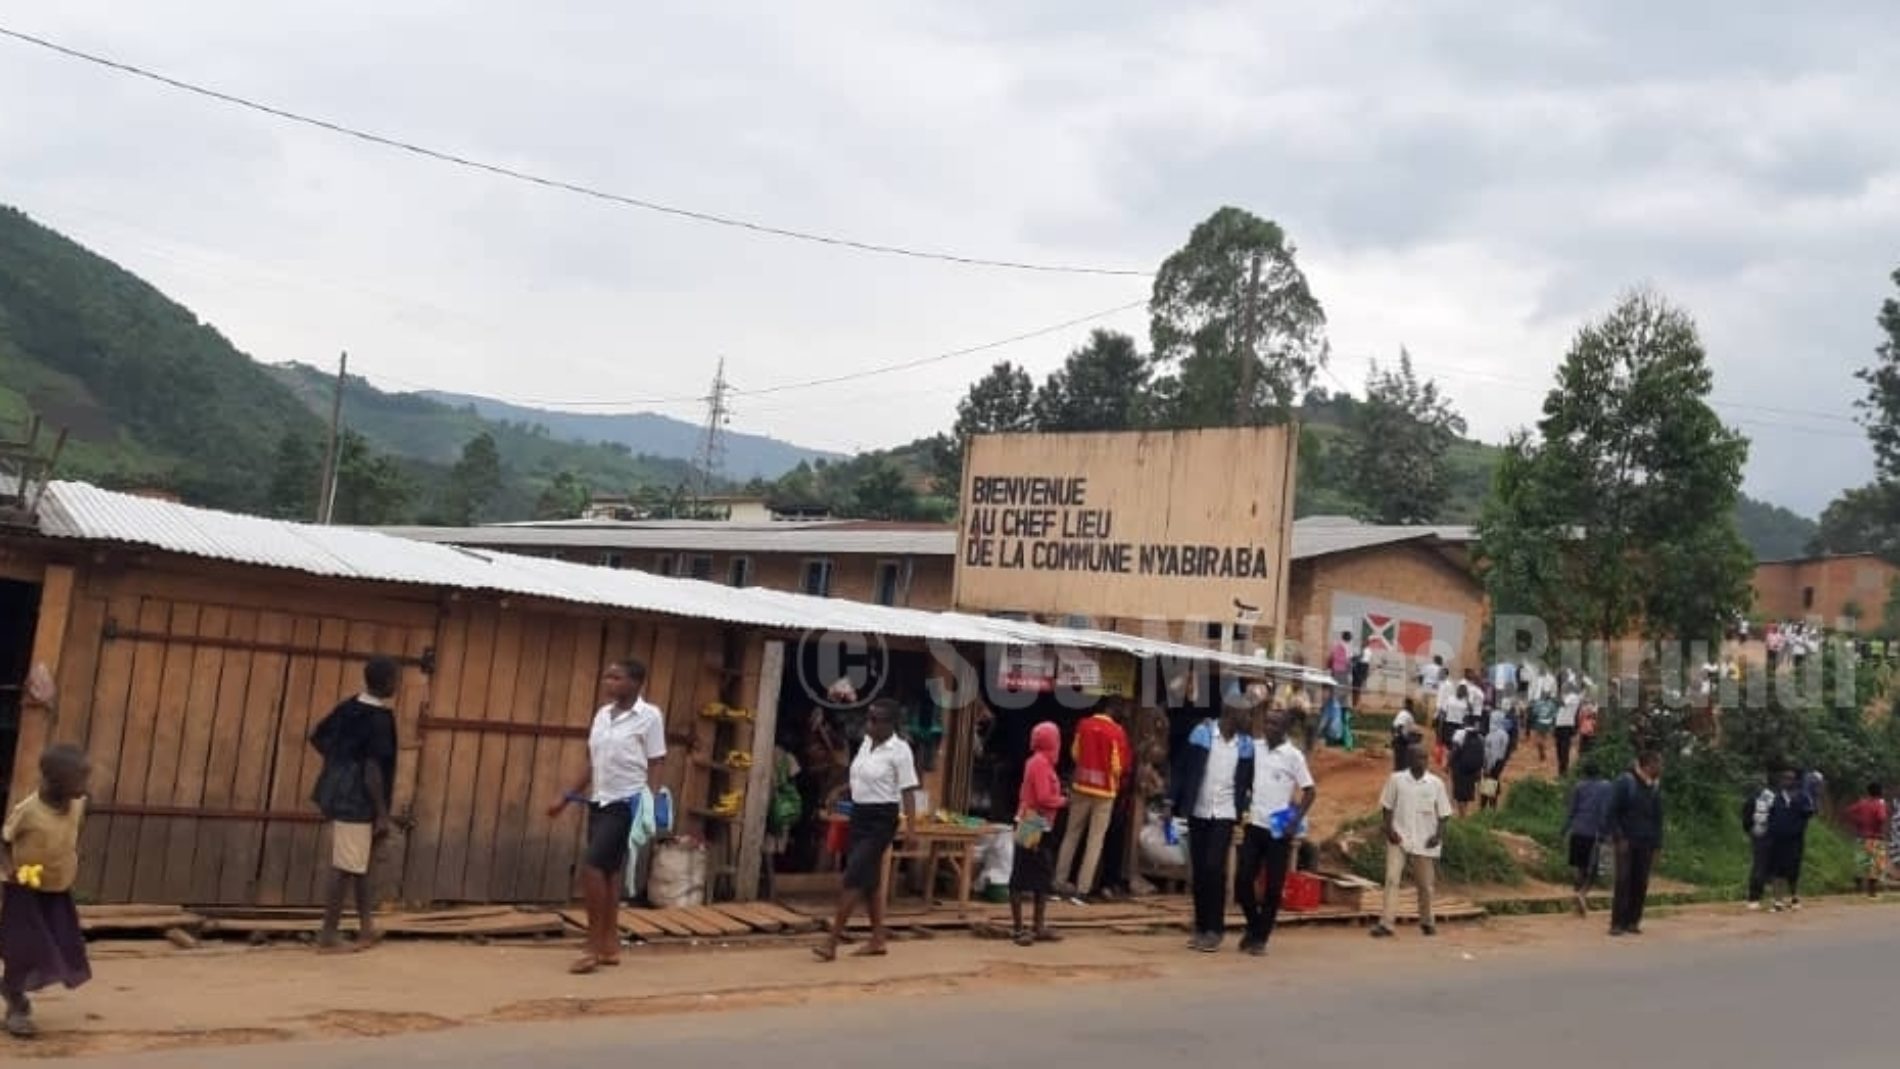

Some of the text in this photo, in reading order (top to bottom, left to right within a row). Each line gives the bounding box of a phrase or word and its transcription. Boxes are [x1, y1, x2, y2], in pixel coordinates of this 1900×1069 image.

[972, 476, 1086, 505] BIENVENUE
[969, 508, 1112, 539] AU CHEF LIEU
[966, 538, 1268, 579] DE LA COMMUNE NYABIRABA
